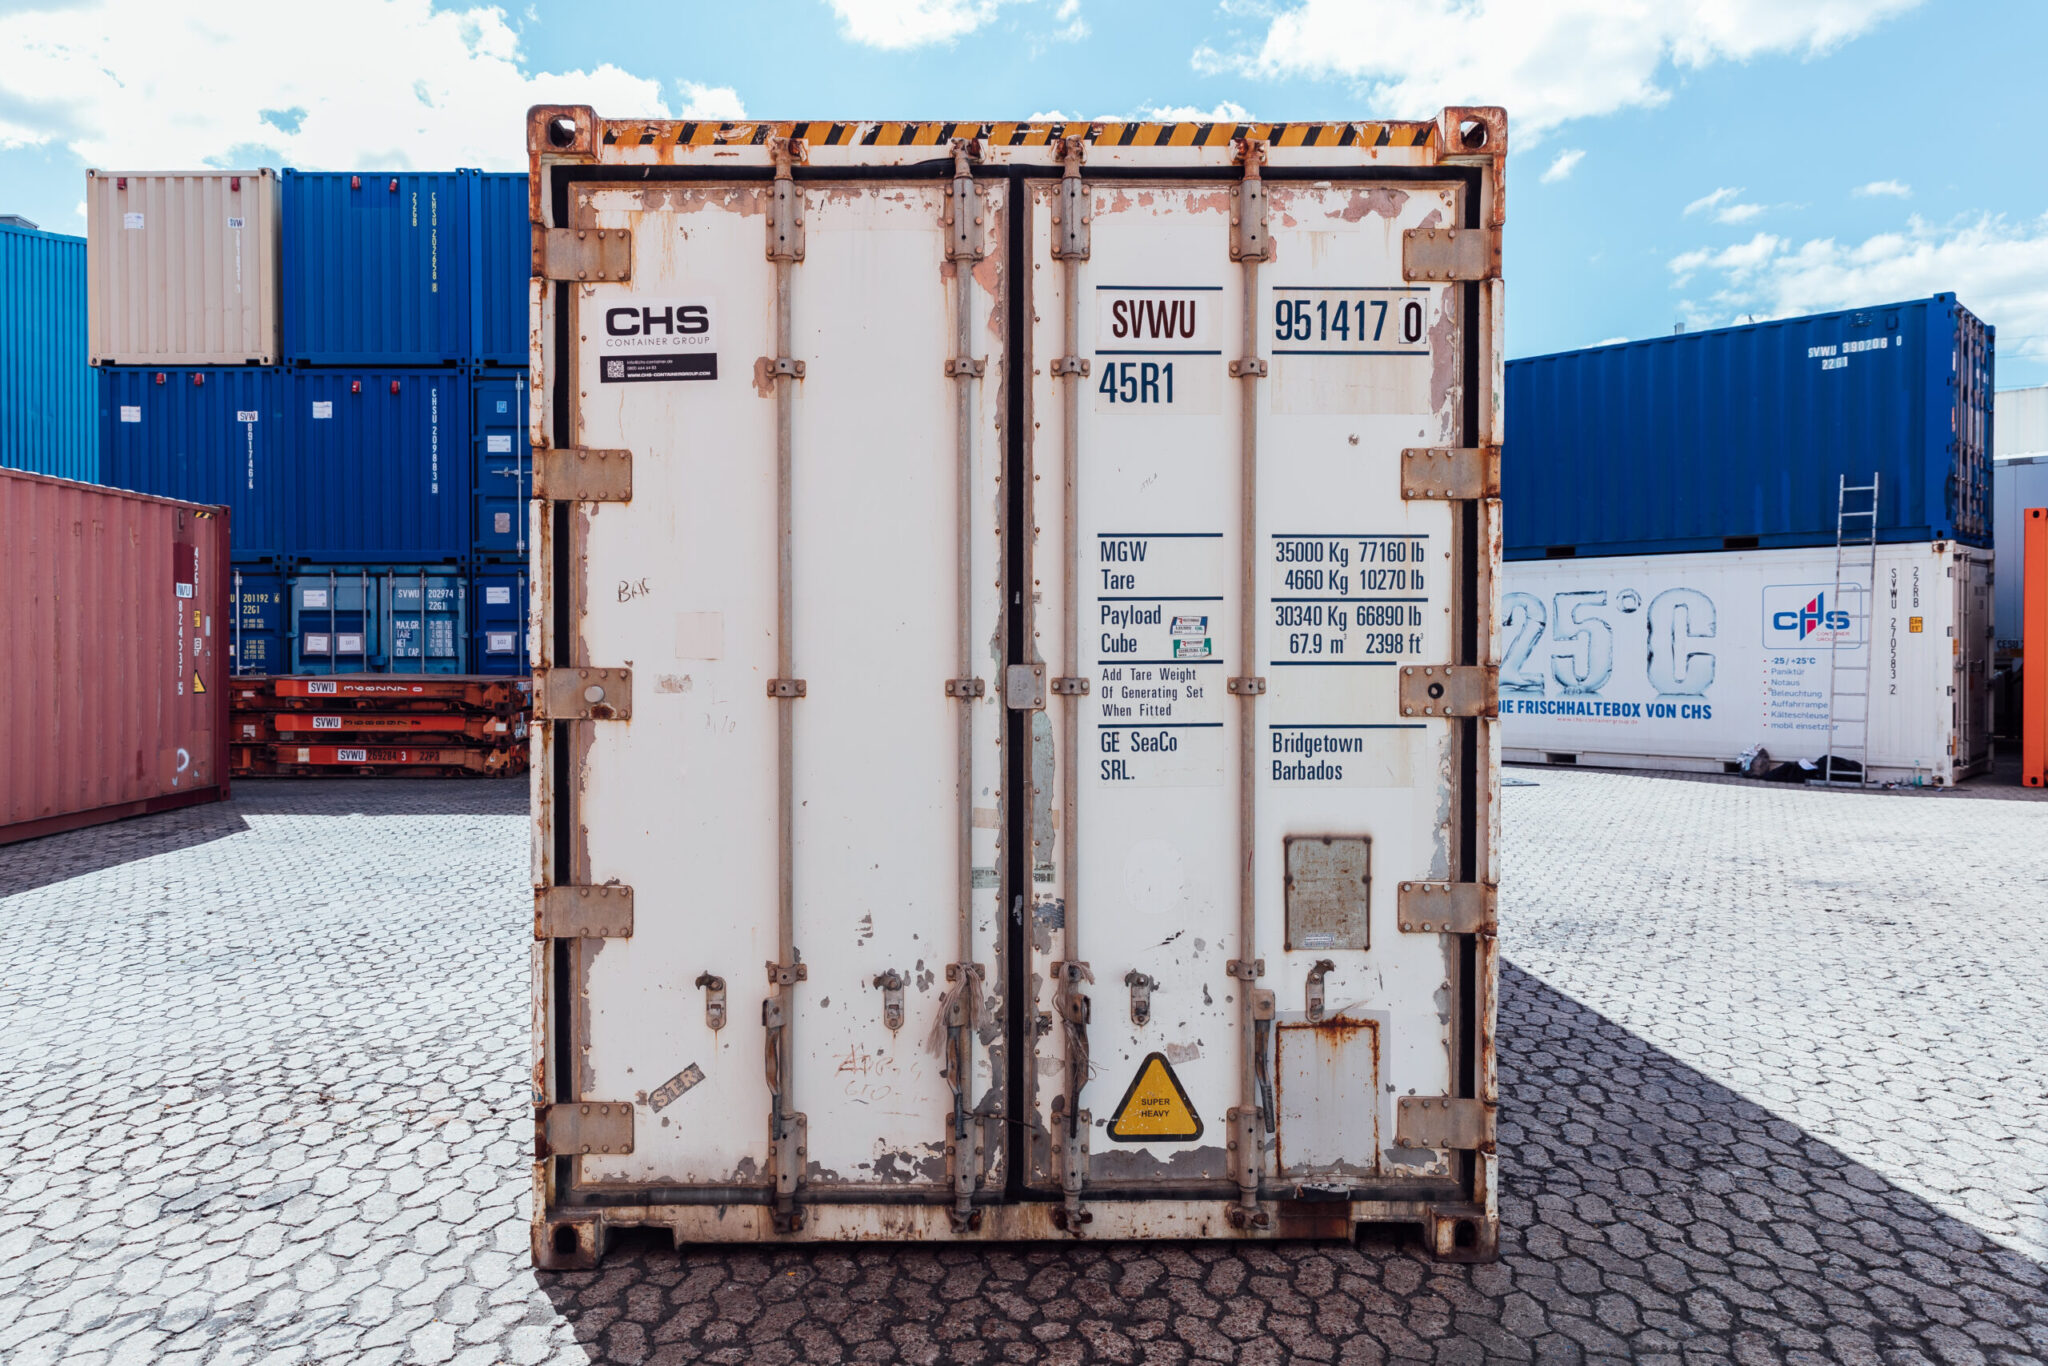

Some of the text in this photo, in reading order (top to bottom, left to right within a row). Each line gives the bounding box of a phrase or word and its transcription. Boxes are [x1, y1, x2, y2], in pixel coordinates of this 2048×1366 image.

[605, 305, 710, 336] CHS
[1112, 299, 1196, 339] SVWU
[1275, 299, 1422, 344] 951417 0
[606, 336, 710, 347] CONTAINER GROUP
[1807, 345, 1838, 358] SVWU
[1098, 362, 1173, 404] 45R1
[1100, 540, 1148, 562] MGW
[1275, 541, 1425, 568] 35000 Kg 77160 lb
[1100, 568, 1135, 590] Tare
[1284, 568, 1424, 596] 4660 Kg 10270 lb
[242, 593, 269, 603] 201192
[397, 589, 420, 599] SVWU
[428, 589, 454, 599] 202974
[242, 605, 260, 614] 22G1
[1101, 604, 1162, 630] Payload
[1275, 605, 1422, 632] 30340 Kg 66890 lb
[1773, 591, 1851, 641] CHS
[396, 639, 406, 648] NET
[1101, 632, 1137, 653] Cube
[1289, 633, 1323, 654] 67.9
[1365, 633, 1404, 654] 2398
[1101, 667, 1196, 684] Add Tare Weight
[310, 681, 335, 692] SVWU
[1101, 685, 1204, 702] Of Generating Set
[1771, 689, 1823, 698] Beleuchtung
[1890, 684, 1897, 695] 2
[1101, 703, 1172, 717] When Fitted
[1517, 700, 1641, 718] FRISCHHALTEBOX
[1646, 702, 1677, 719] VON
[1681, 704, 1712, 720] CHS
[1771, 700, 1829, 709] Auffahrrampe
[315, 717, 340, 728] SVWU
[1100, 730, 1178, 753] GE SeaCo
[1272, 731, 1363, 759] Bridgetown
[340, 751, 365, 761] SVWU
[401, 751, 407, 761] 3
[1100, 759, 1135, 781] SRL.
[1272, 759, 1343, 781] Barbados
[1141, 1097, 1170, 1106] SUPER
[1141, 1109, 1170, 1117] HEAVY
